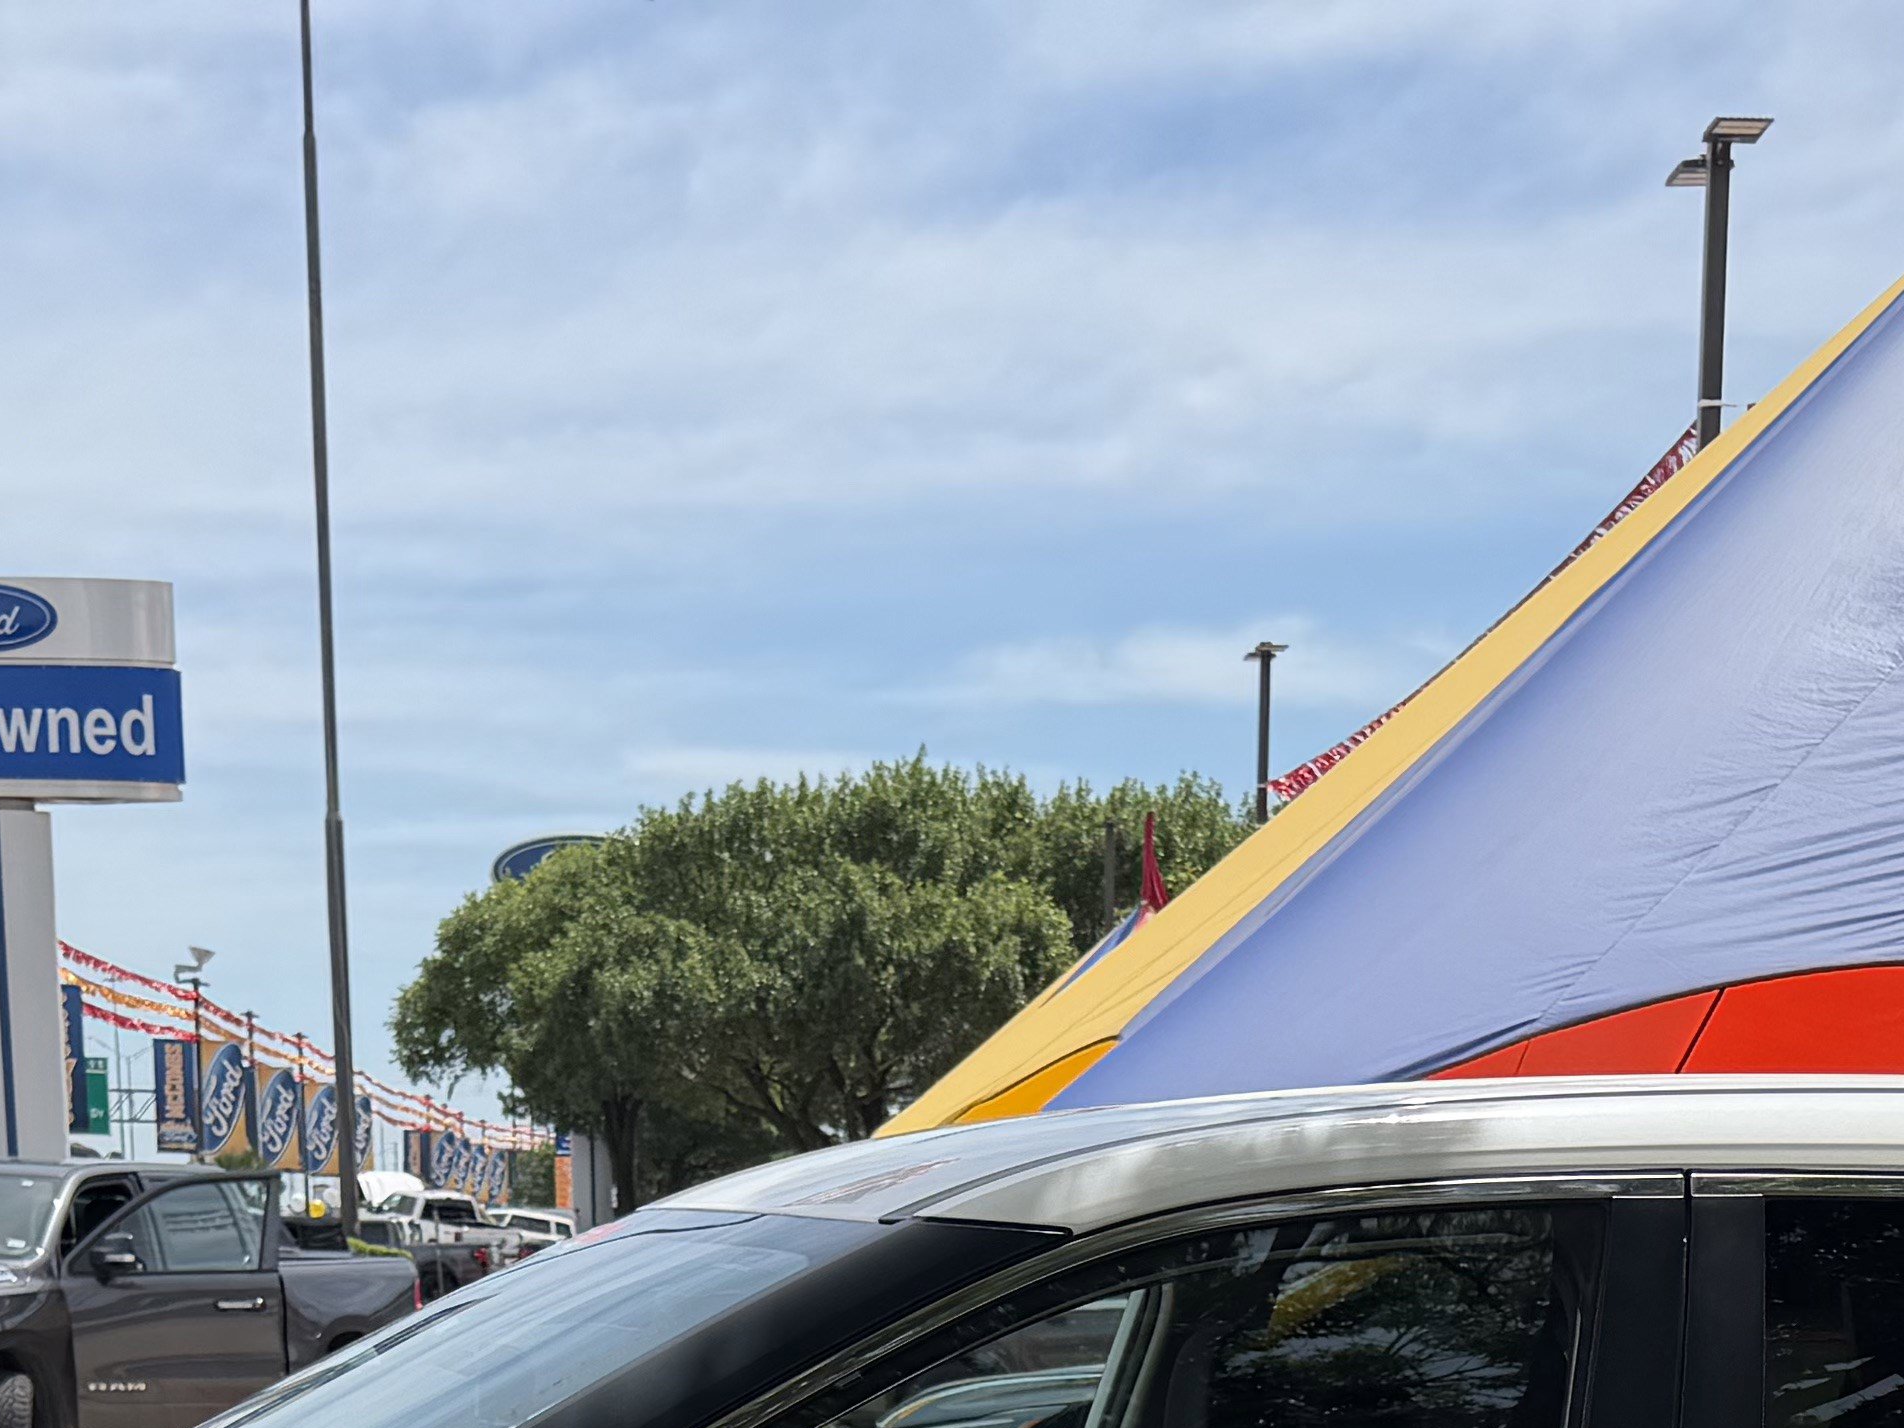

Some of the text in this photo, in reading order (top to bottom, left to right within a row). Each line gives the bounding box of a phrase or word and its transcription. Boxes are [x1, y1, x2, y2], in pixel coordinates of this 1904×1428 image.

[202, 1059, 243, 1137] Ford
[261, 1084, 294, 1153] Ford
[307, 1097, 337, 1160] Ford
